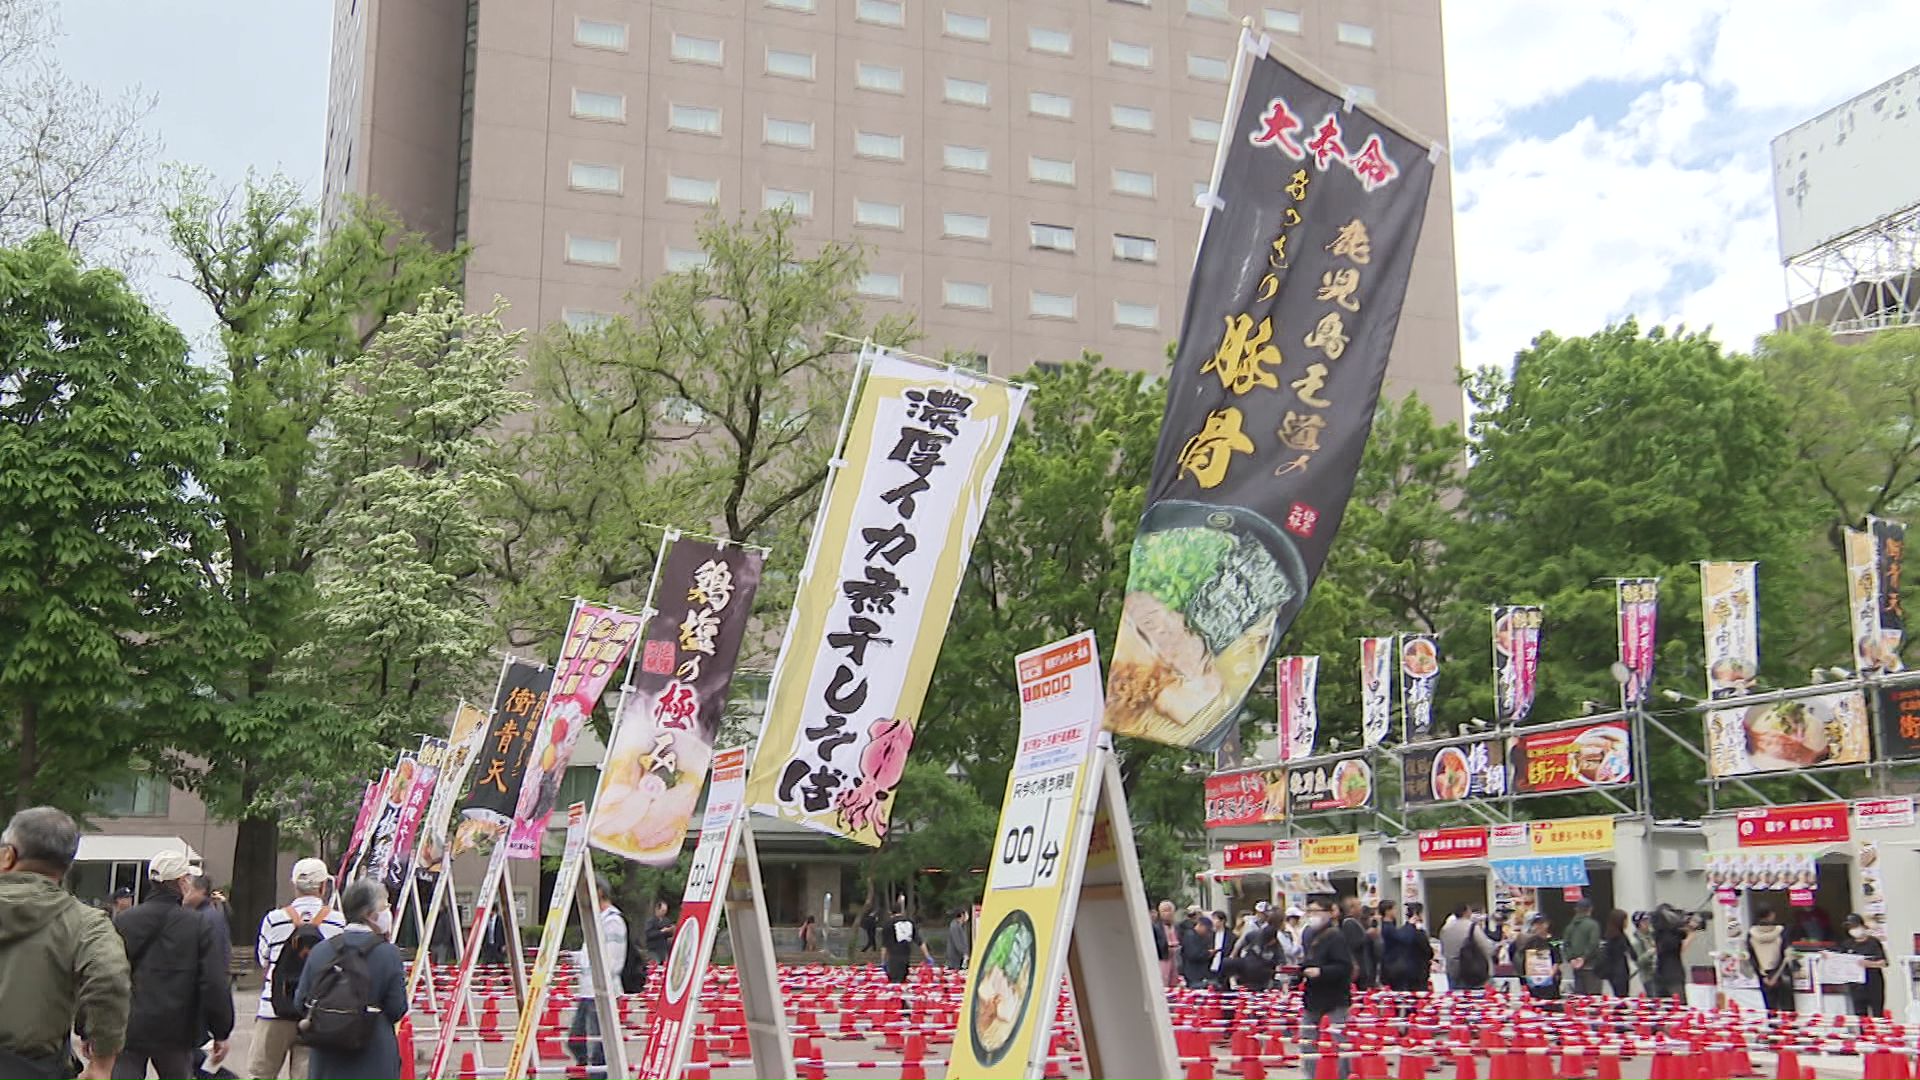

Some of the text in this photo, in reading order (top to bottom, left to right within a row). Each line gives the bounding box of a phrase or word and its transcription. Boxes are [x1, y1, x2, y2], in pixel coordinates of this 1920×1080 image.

[1250, 98, 1399, 191] 大本命
[778, 389, 973, 812] 濃厚イカ煮干しそば
[479, 686, 537, 794] 衝青天
[1003, 825, 1059, 878] 00 分
[1500, 863, 1584, 883] 野青竹手打ち
